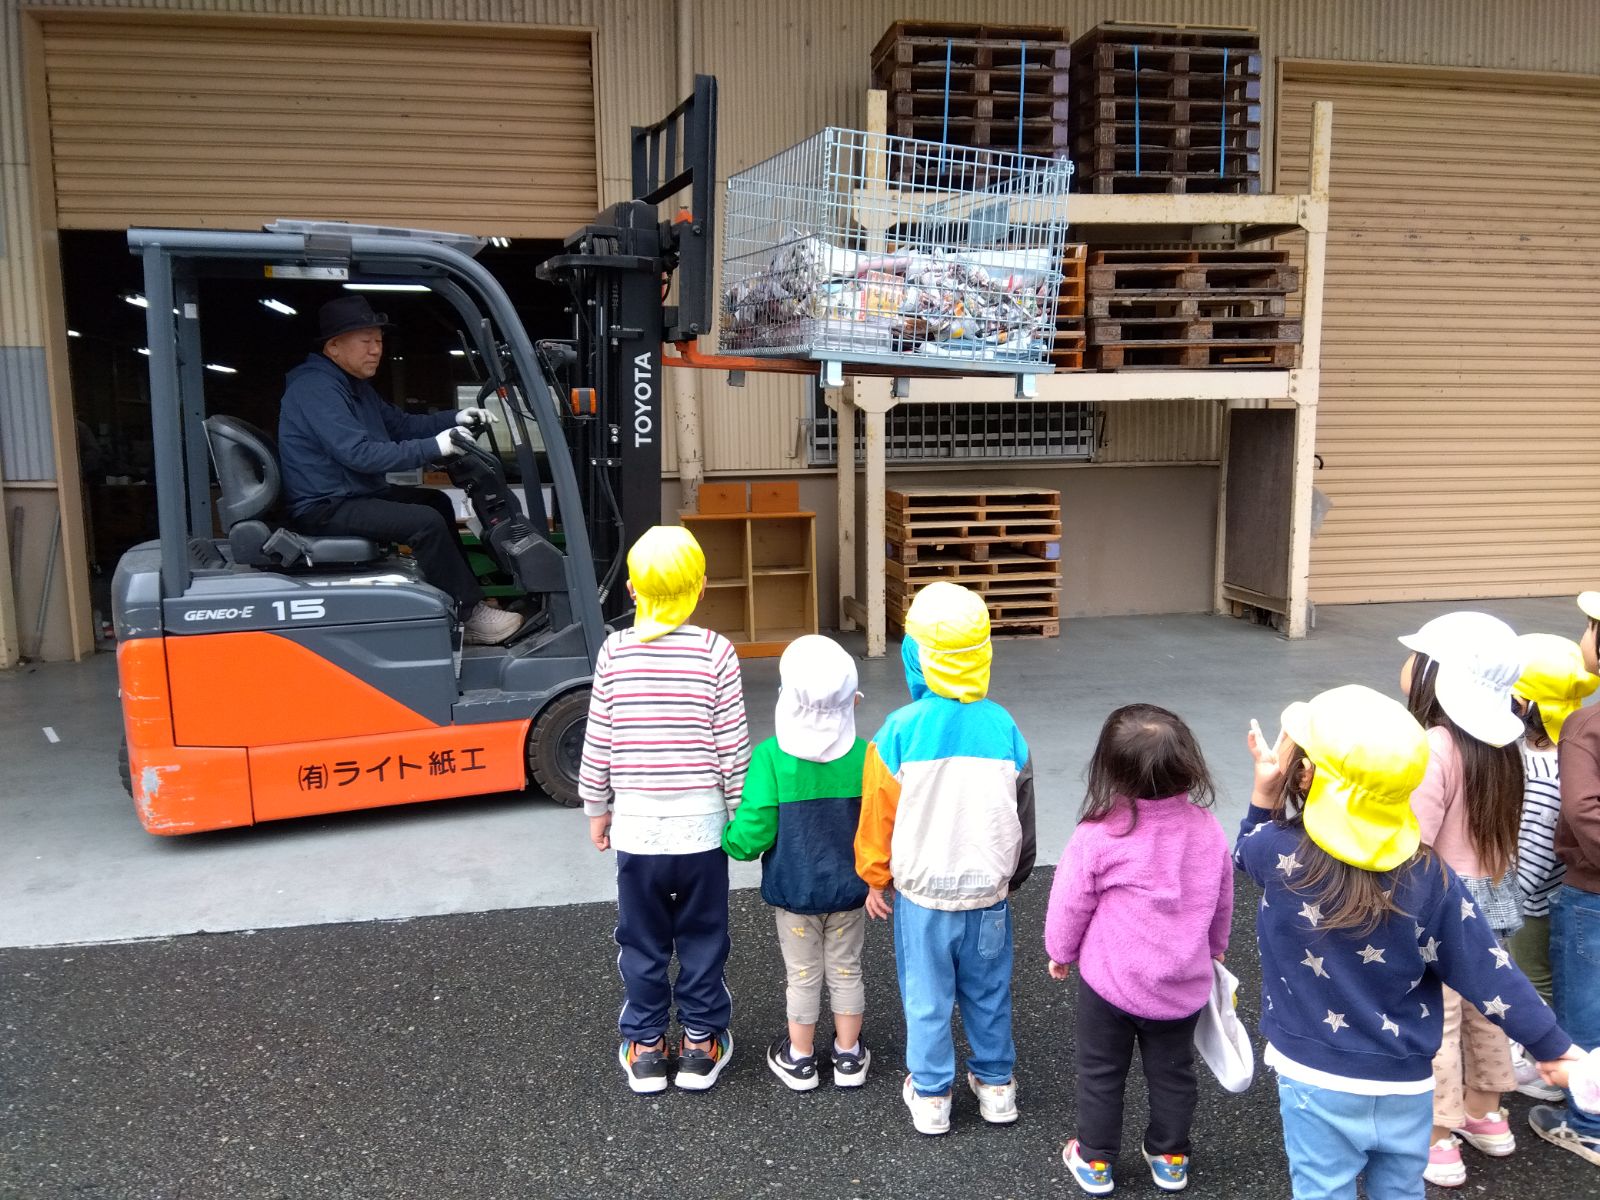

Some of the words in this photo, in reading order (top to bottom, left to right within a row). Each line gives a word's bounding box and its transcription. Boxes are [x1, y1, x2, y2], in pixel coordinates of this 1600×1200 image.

[634, 351, 652, 448] TOYOTA
[184, 605, 255, 621] GENEO-E
[271, 598, 326, 621] 15
